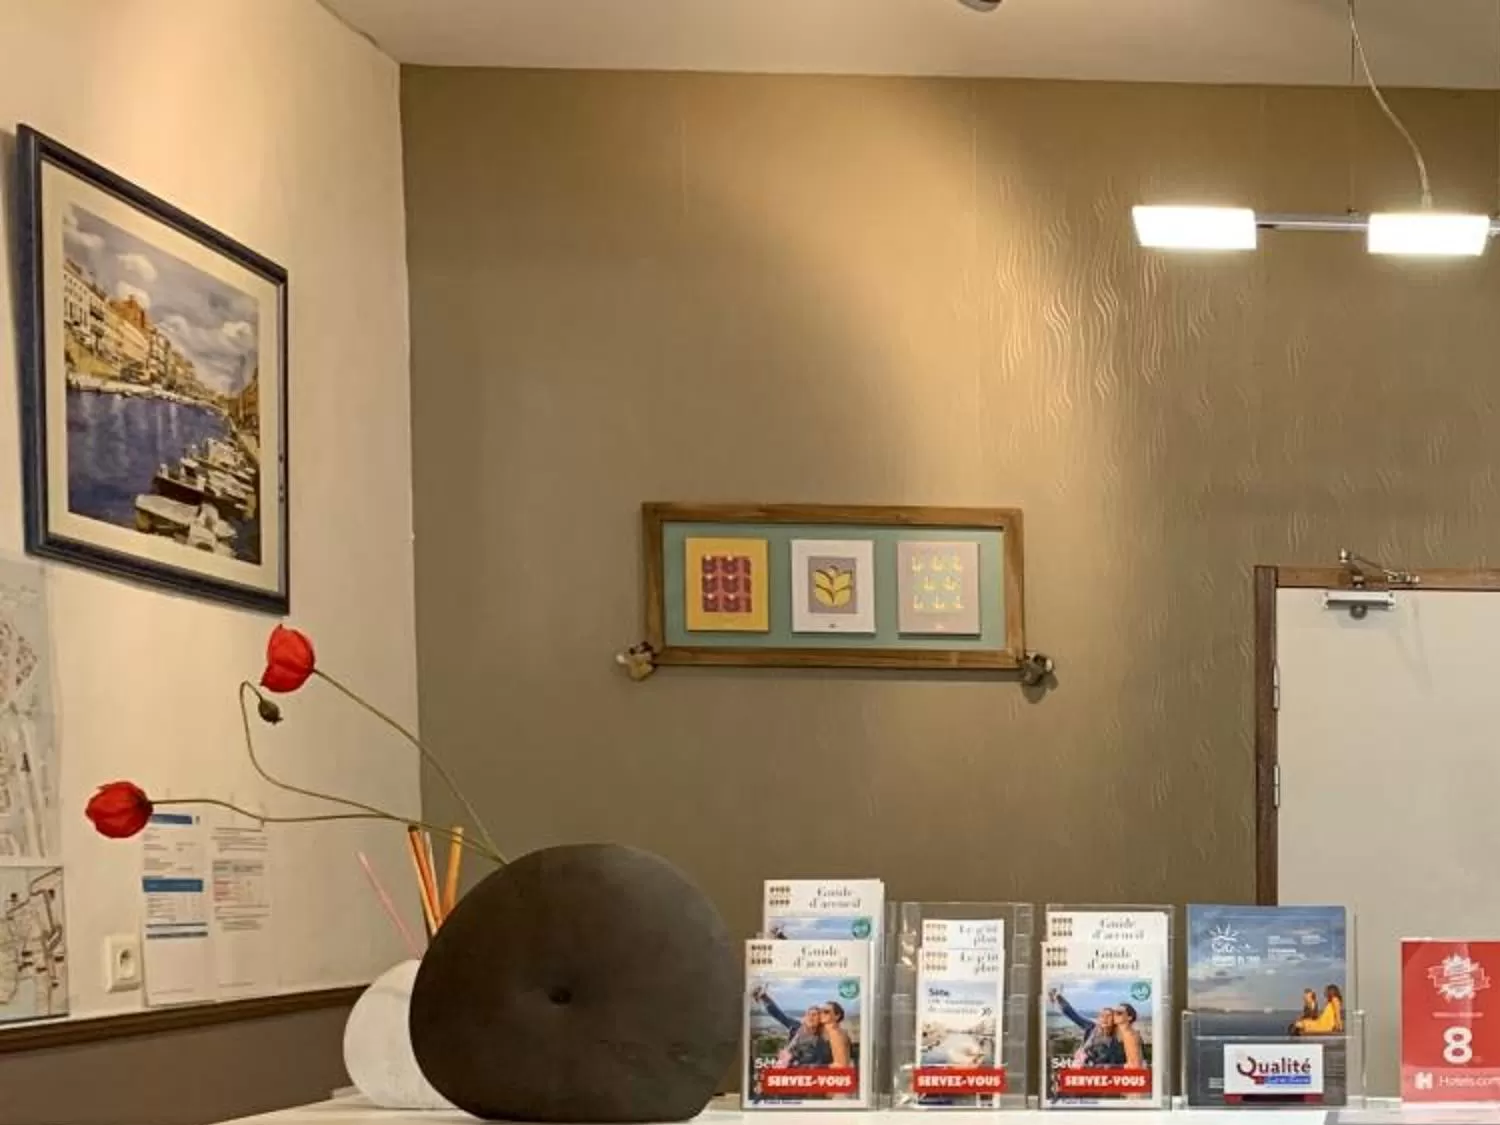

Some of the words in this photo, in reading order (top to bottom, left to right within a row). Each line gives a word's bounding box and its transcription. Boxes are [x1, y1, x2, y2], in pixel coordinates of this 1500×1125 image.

[1443, 1026, 1472, 1063] 8
[1236, 1056, 1312, 1077] Qualité
[767, 1075, 852, 1087] SERVEZ-VOUS
[917, 1075, 1001, 1087] SERVEZ-VOUS
[1064, 1075, 1146, 1087] SERVEZ-VOUS
